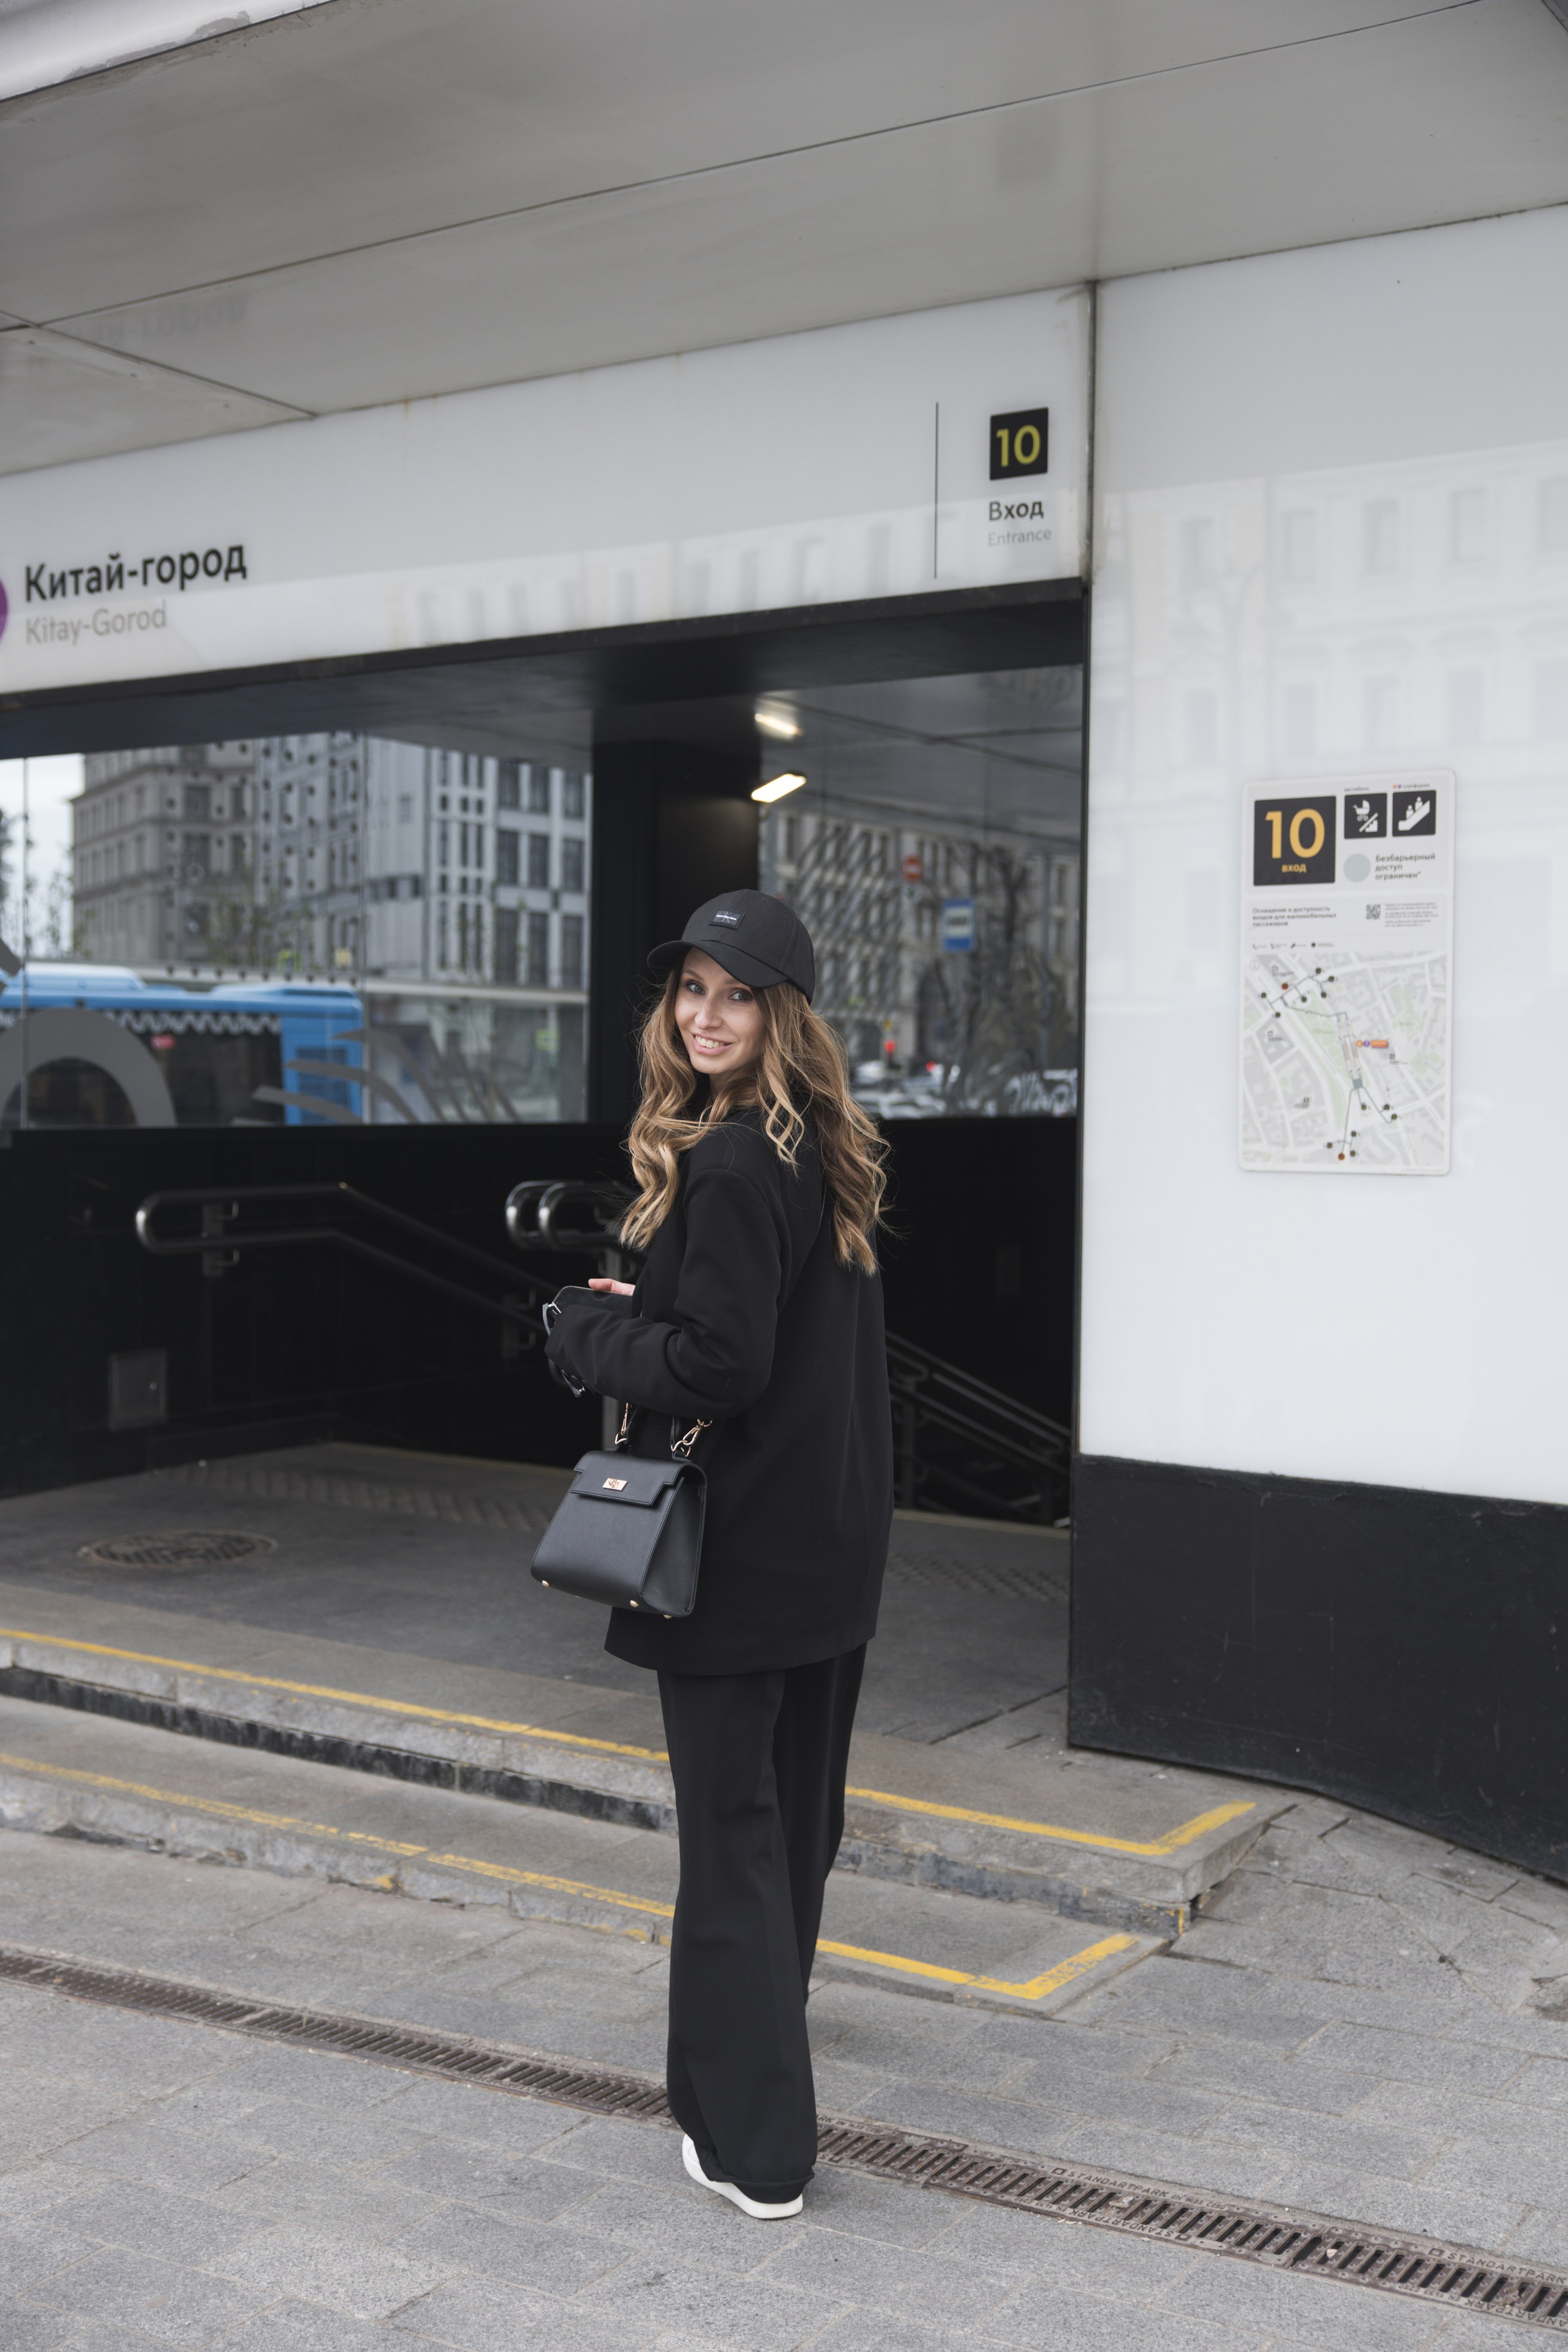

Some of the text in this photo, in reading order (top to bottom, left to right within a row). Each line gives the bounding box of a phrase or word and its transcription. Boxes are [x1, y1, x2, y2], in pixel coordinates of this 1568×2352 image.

[996, 425, 1041, 467] 10
[989, 501, 1044, 521] Вход
[988, 529, 1052, 546] Entrance
[25, 545, 247, 602] Китай-город
[26, 600, 166, 646] Kitay-Gorod
[1265, 809, 1325, 859] 10
[1376, 853, 1436, 862] Безбарьерный
[1068, 2171, 1169, 2198] STANDARTPARK
[1069, 2209, 1175, 2237] STANDARTPARK
[1447, 2253, 1567, 2285] STANDARTPARK
[1464, 2299, 1568, 2328] ANDARTPARK
